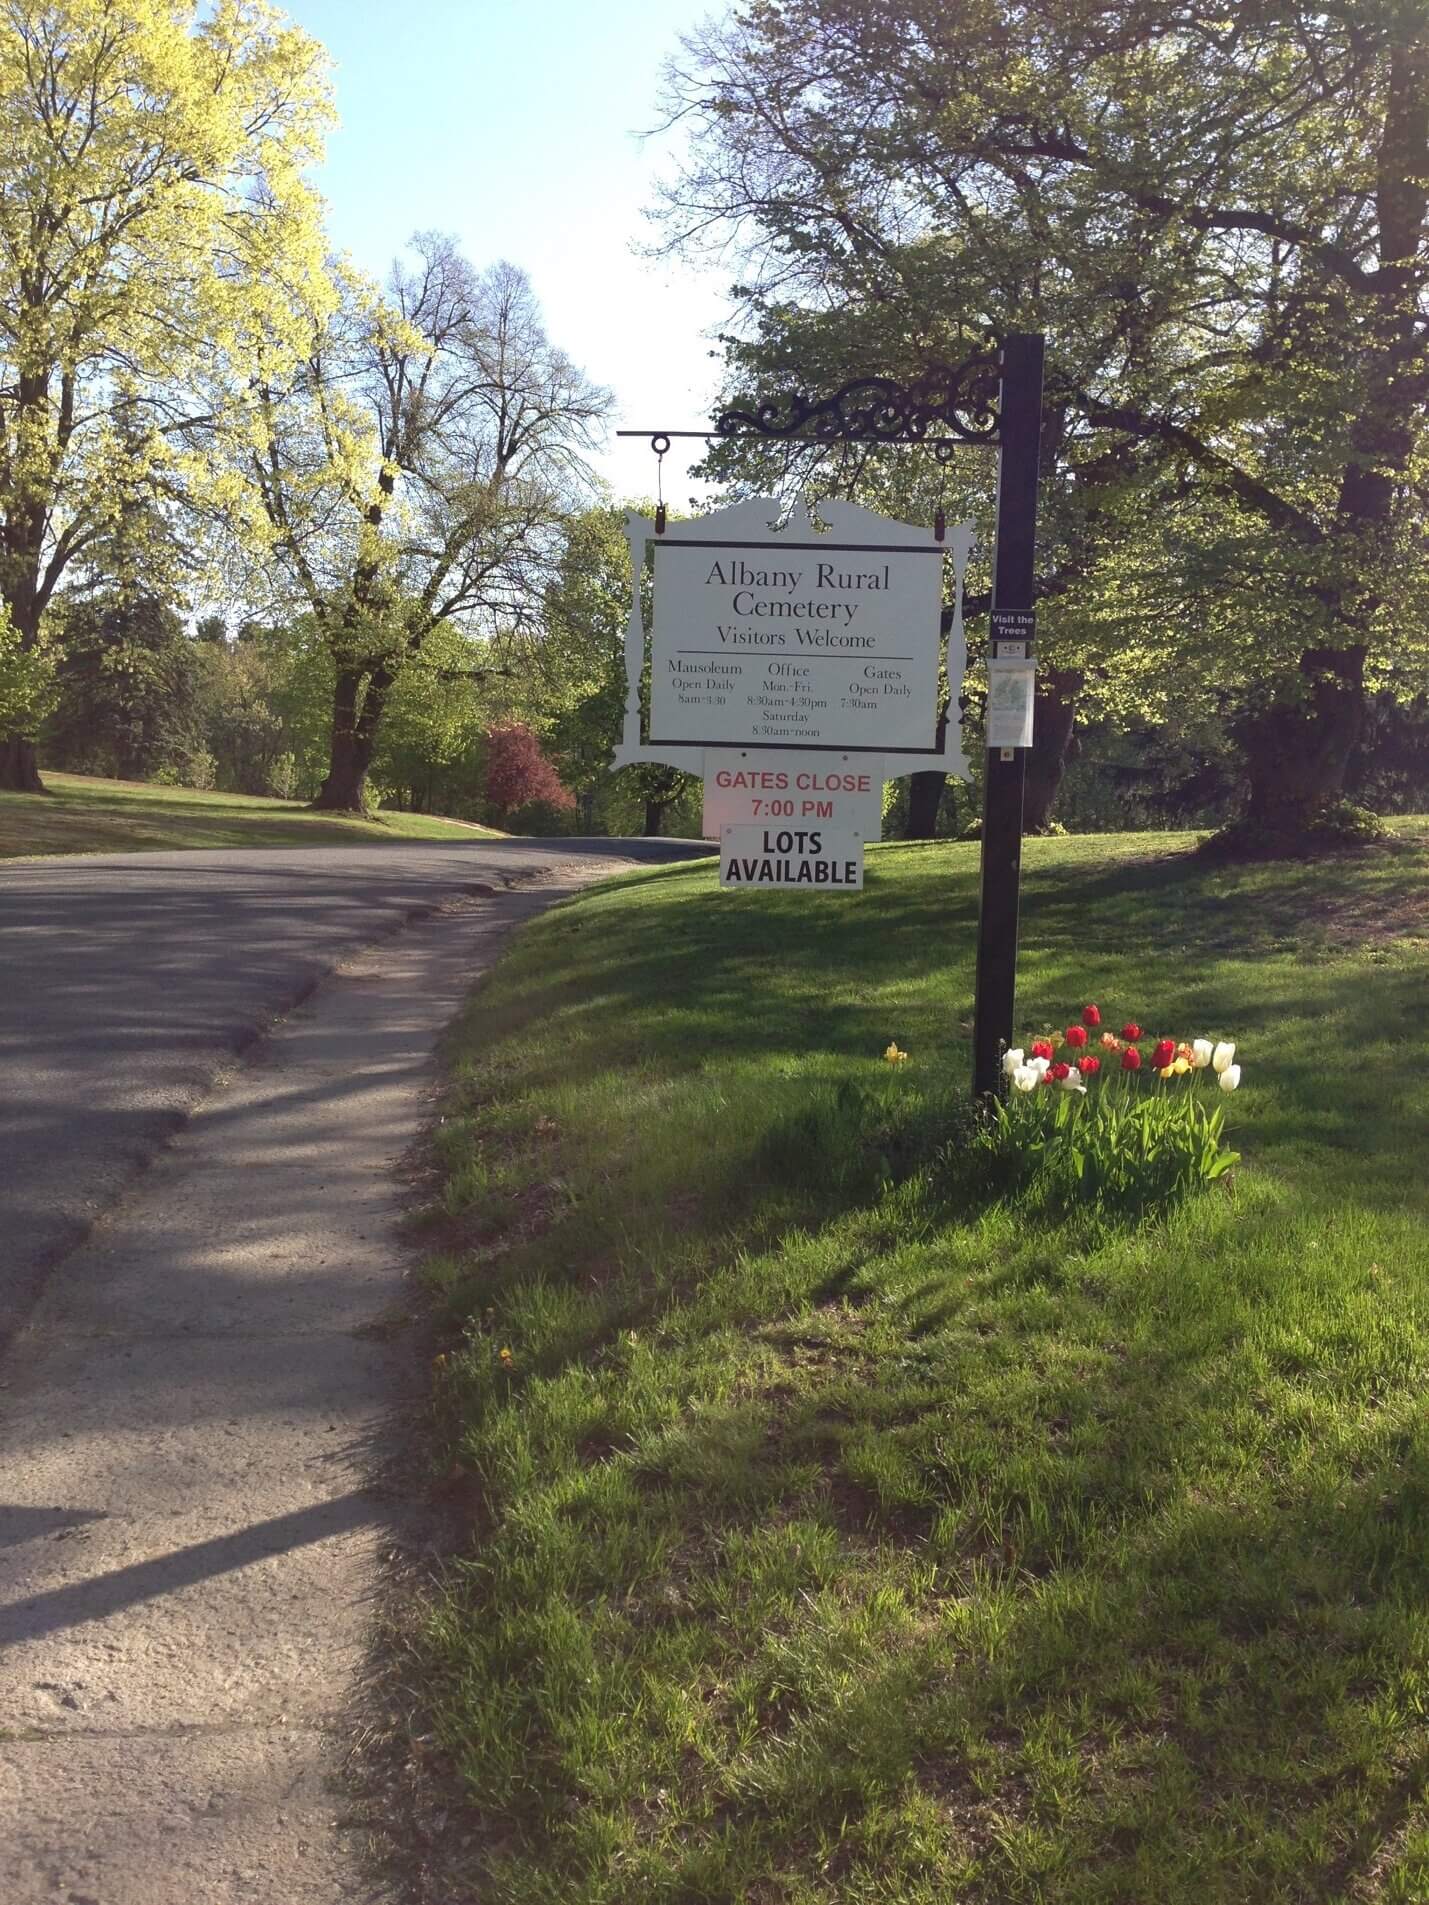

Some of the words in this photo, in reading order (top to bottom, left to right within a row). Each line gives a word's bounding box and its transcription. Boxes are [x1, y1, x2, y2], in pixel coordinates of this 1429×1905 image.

[705, 561, 802, 593] Albany
[816, 563, 890, 590] Rural
[732, 591, 858, 626] Cemetery
[992, 615, 1015, 624] Visit
[1017, 615, 1034, 624] the
[716, 626, 785, 645] Visitors
[796, 629, 876, 648] Welcome
[998, 626, 1027, 635] Trees
[668, 660, 742, 675] Mausoleum
[768, 662, 810, 677] Office
[864, 665, 902, 679] Gates
[672, 678, 701, 691] Open
[706, 679, 735, 693] Daily
[849, 683, 879, 696] Open
[884, 683, 911, 698] Daily
[763, 710, 809, 724] Saturday
[716, 771, 789, 790] GATES
[797, 774, 871, 792] CLOSE
[752, 800, 794, 816] 7:00
[802, 801, 833, 818] PM
[763, 831, 822, 855] LOTS
[726, 859, 857, 884] AVAILABLE
